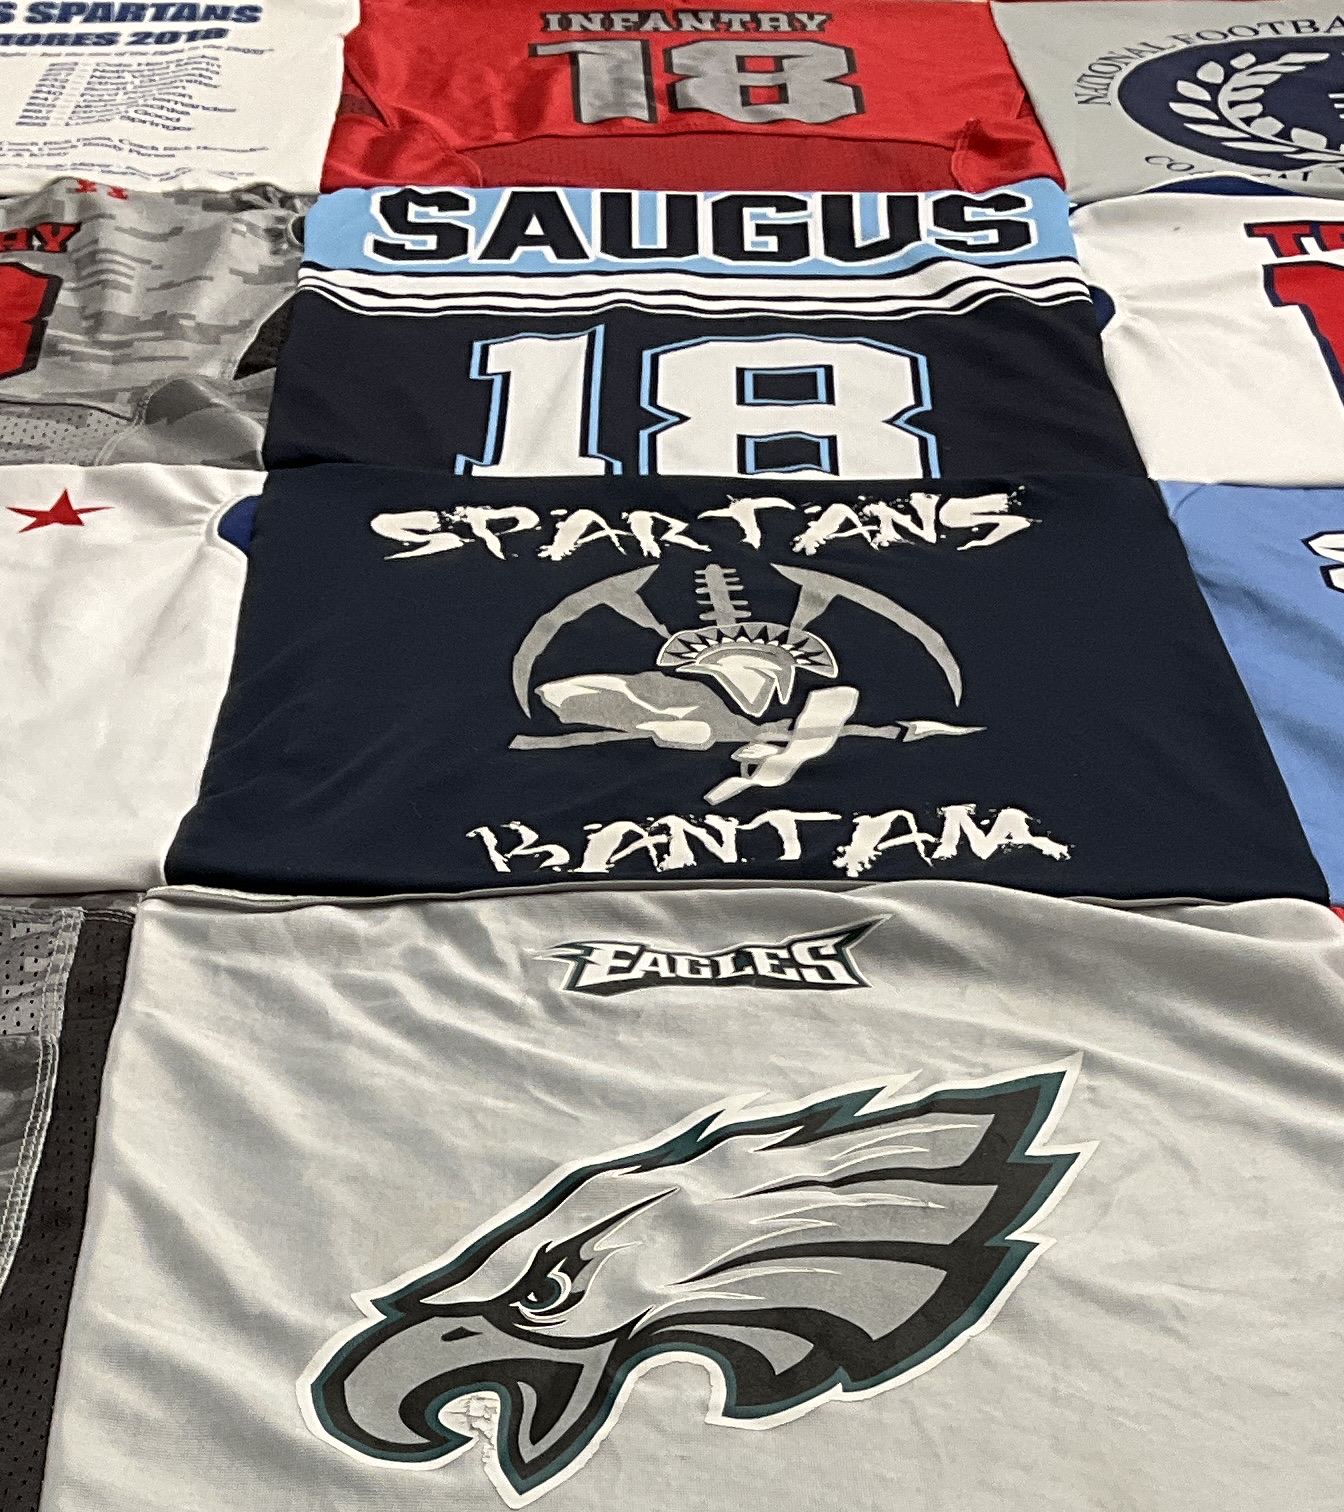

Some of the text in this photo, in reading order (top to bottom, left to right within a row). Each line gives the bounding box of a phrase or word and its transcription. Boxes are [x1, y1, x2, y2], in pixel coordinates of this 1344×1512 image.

[24, 1, 263, 24] SPARTANS
[541, 9, 832, 33] INFANTRY
[527, 38, 866, 125] 18
[1074, 42, 1177, 107] NATIONAL
[365, 186, 1039, 264] SAUGUS
[456, 322, 941, 480] 18
[368, 486, 1043, 563] SPARTANS
[464, 803, 1078, 878] BANTAM
[571, 932, 862, 988] EAGLES
